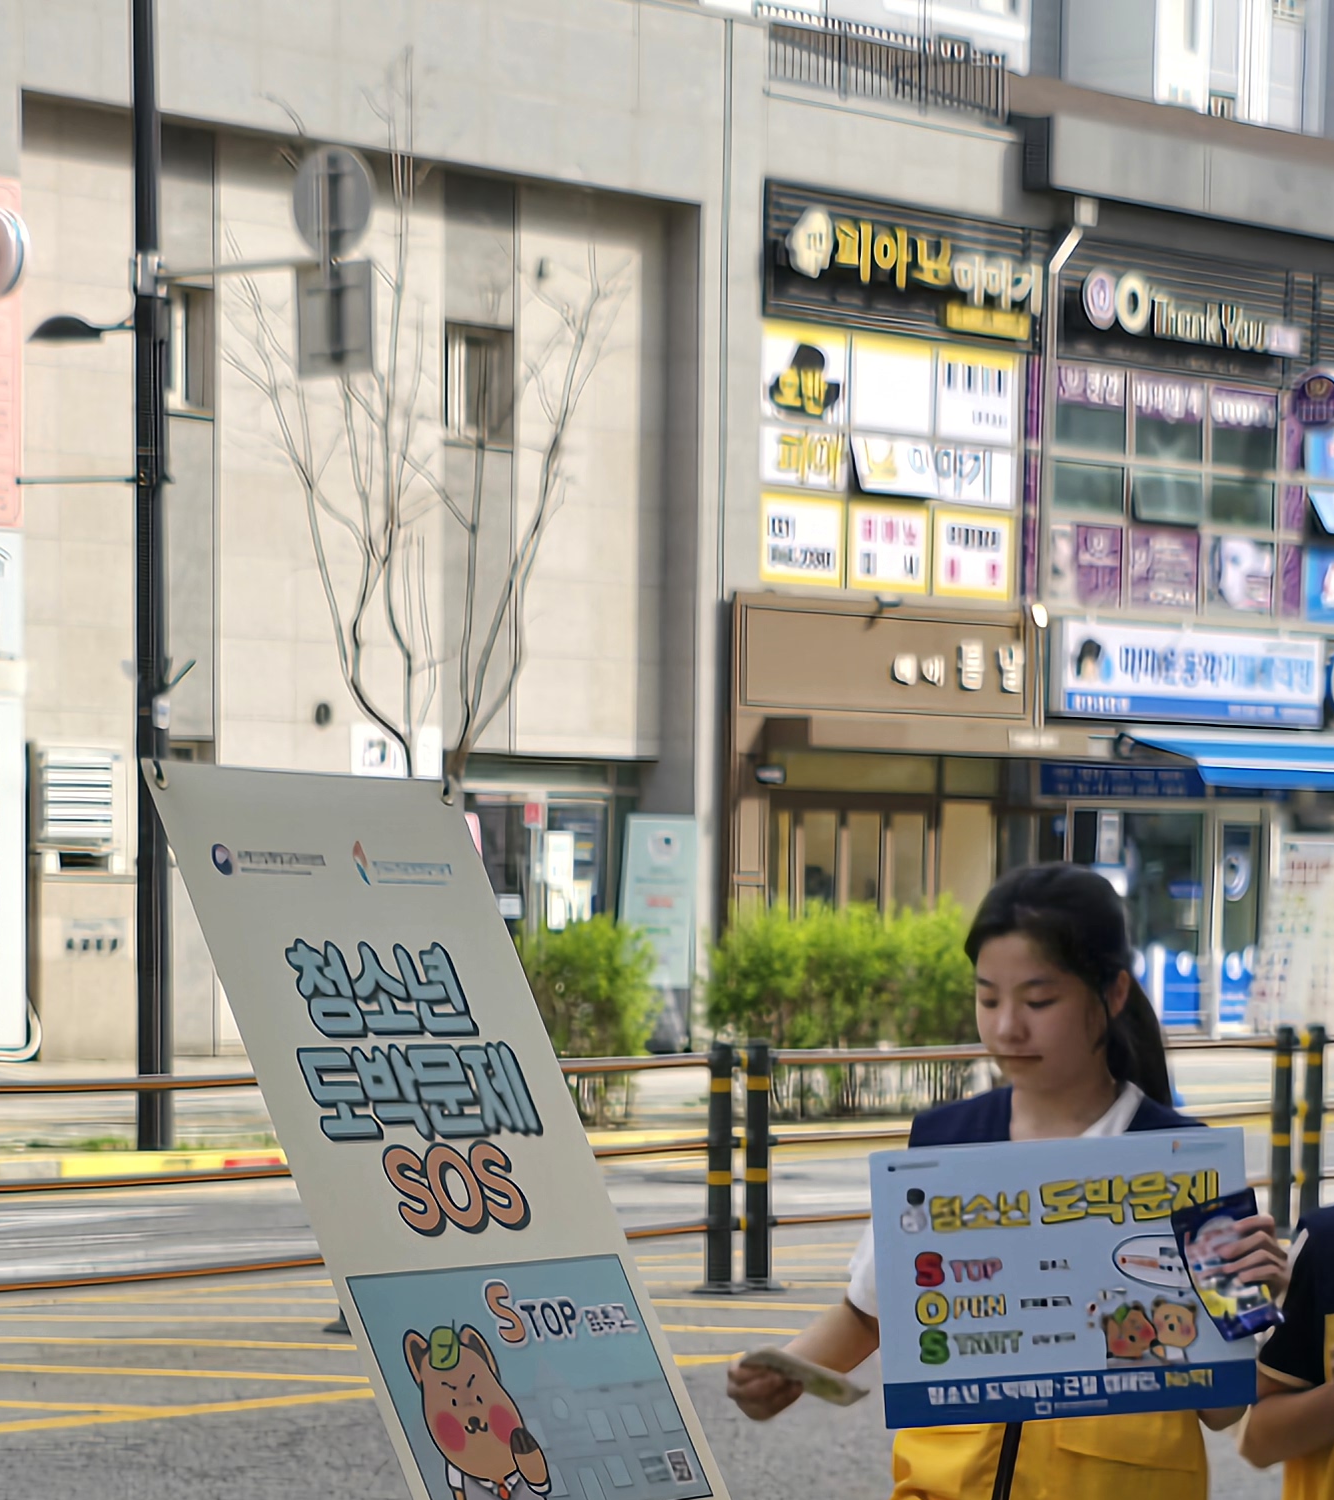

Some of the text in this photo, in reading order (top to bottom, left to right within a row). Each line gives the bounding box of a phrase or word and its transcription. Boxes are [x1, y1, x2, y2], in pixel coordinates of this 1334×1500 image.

[284, 937, 479, 1038] 청소년
[295, 1040, 544, 1143] 도박문제
[381, 1140, 532, 1238] SOS
[1040, 1168, 1220, 1225] 도박문제
[481, 1278, 578, 1347] STOP
